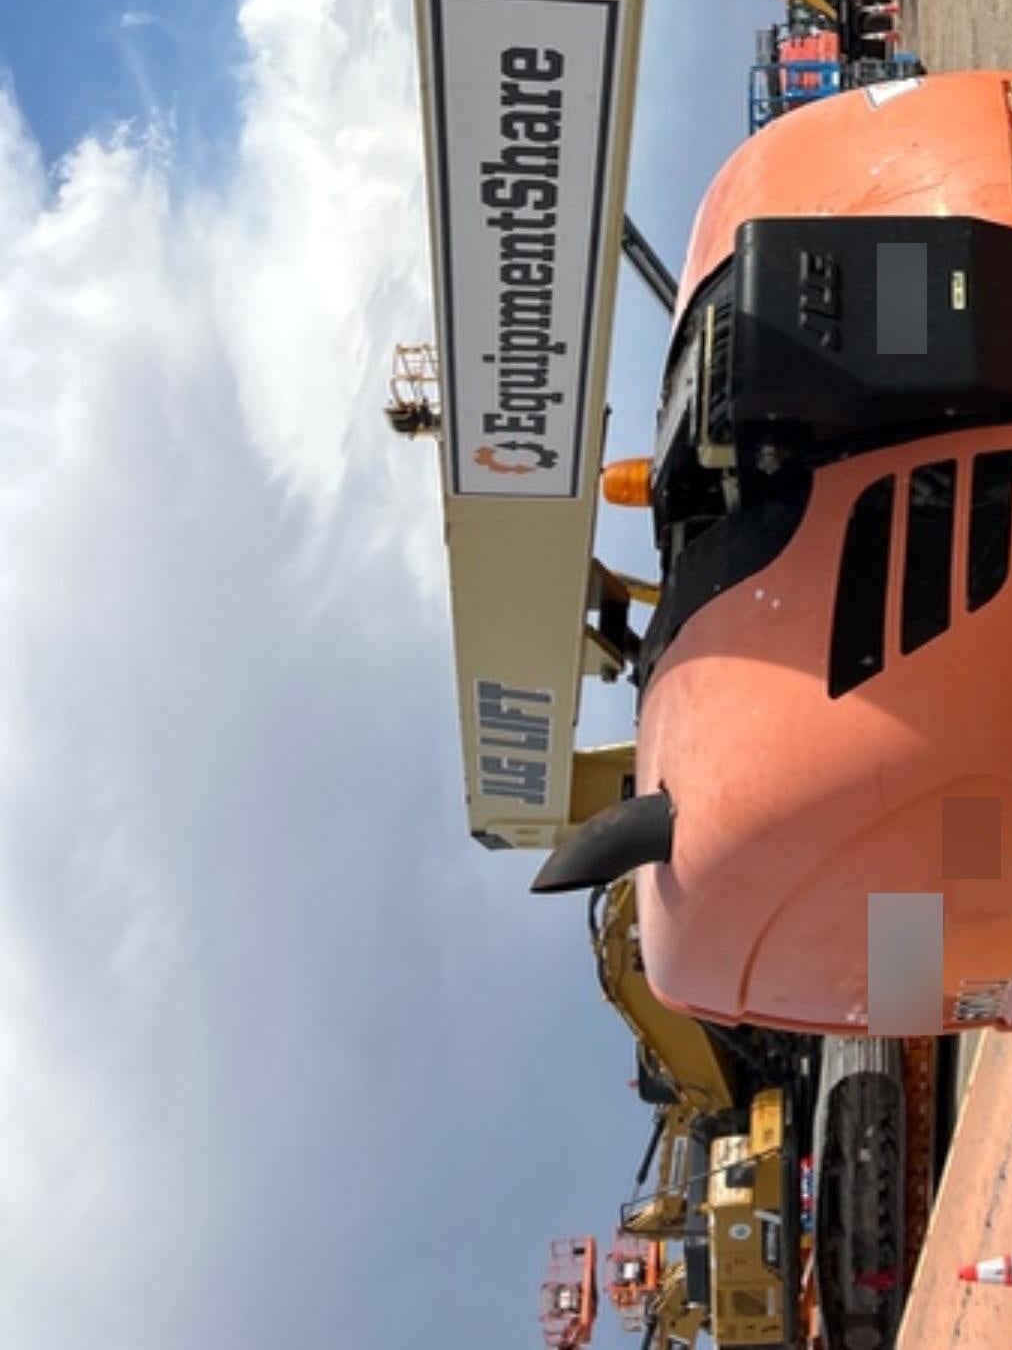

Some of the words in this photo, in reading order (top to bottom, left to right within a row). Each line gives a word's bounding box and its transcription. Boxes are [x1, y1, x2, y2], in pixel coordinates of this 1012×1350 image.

[480, 48, 566, 436] EquipmentShare
[799, 251, 839, 350] JLG
[477, 680, 553, 754] LIFT
[480, 755, 547, 806] JLG
